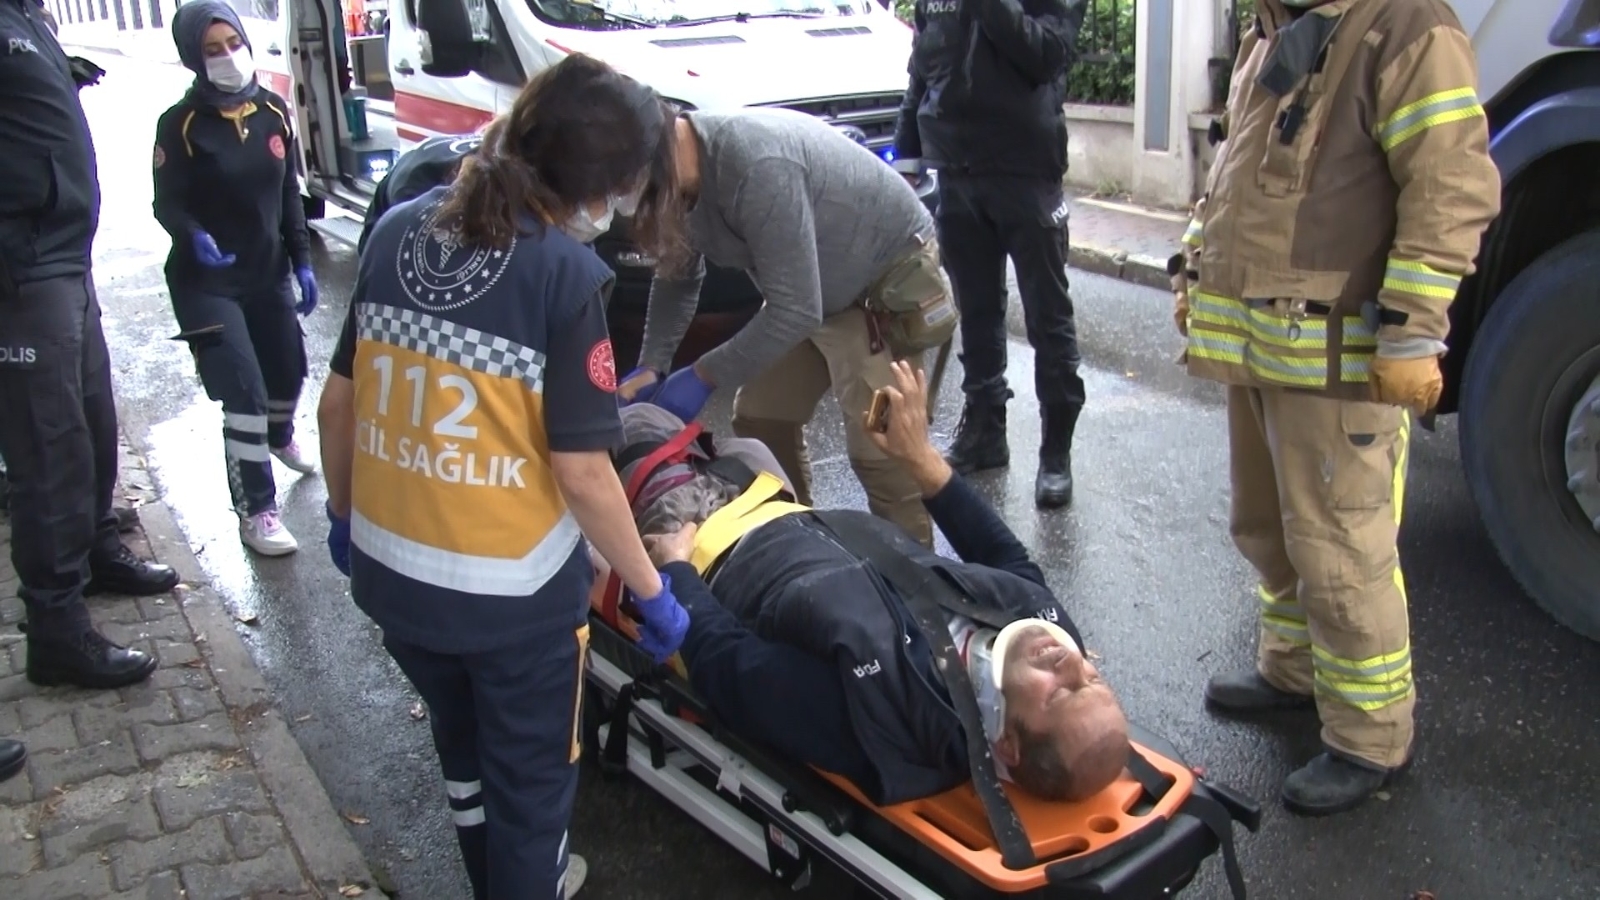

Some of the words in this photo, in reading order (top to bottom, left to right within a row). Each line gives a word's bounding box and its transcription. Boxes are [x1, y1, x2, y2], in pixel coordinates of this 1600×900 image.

[373, 355, 478, 440] 112
[358, 418, 391, 462] CİL
[396, 442, 528, 489] SAĞLIK
